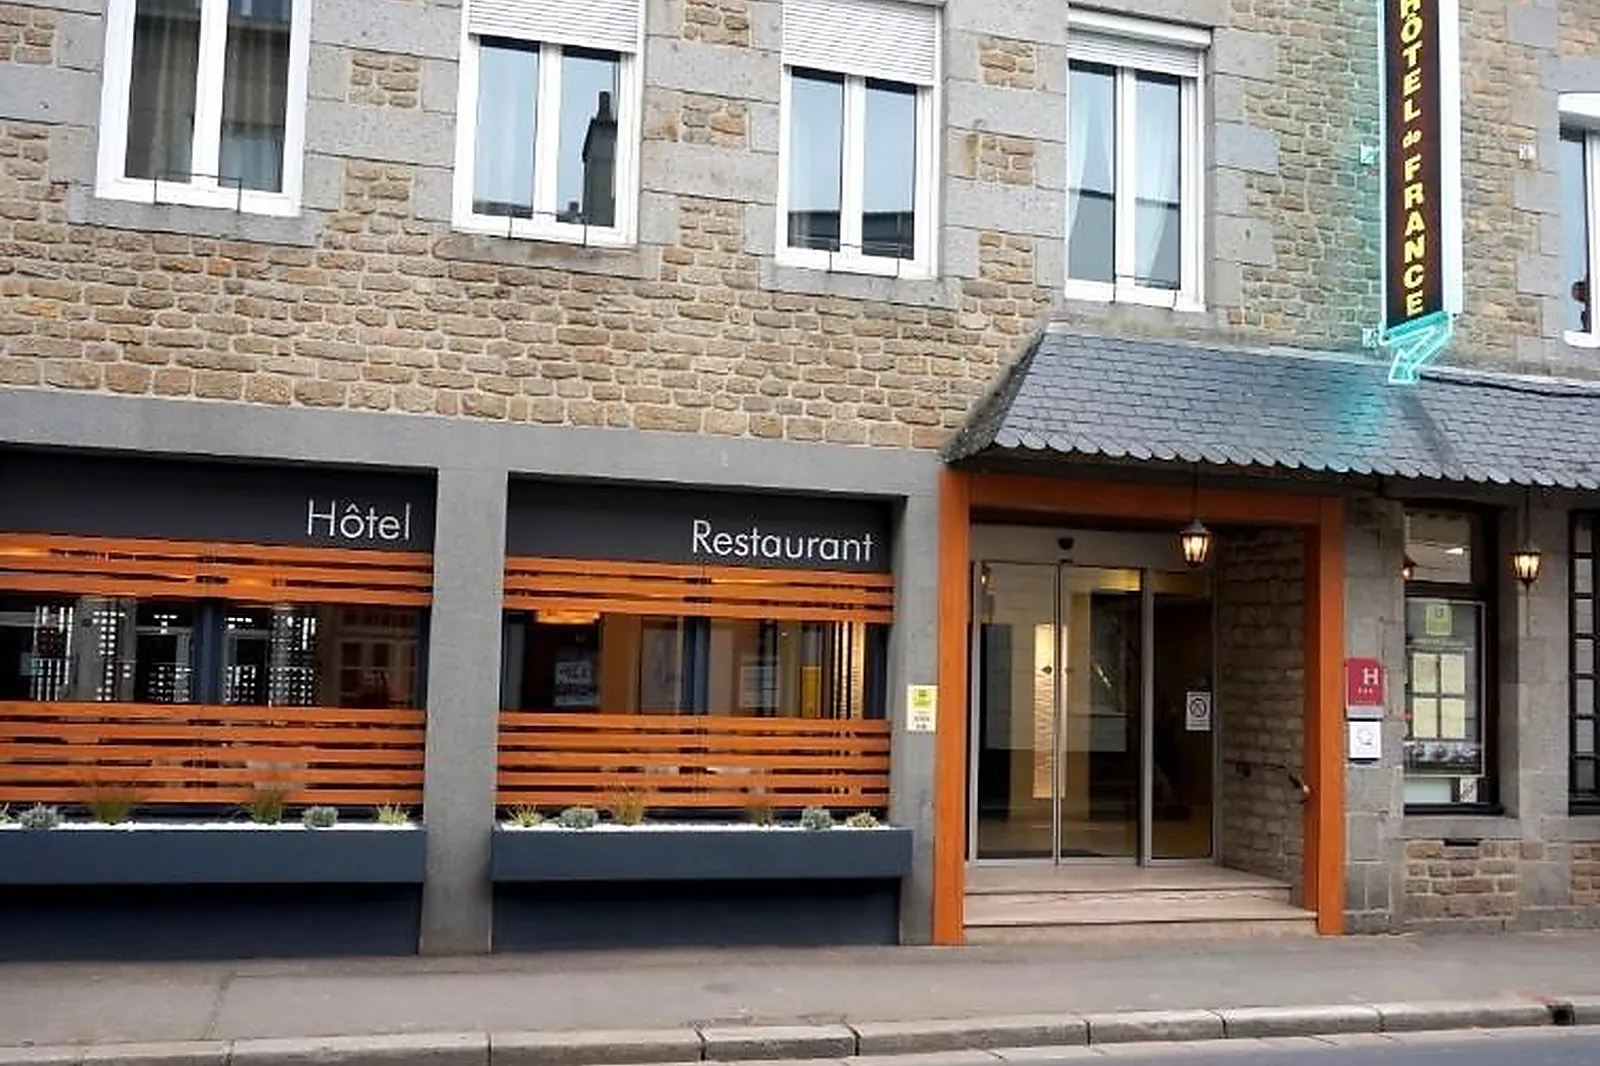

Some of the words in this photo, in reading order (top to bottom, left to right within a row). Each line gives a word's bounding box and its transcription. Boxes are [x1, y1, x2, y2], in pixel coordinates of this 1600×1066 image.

[1400, 0, 1423, 122] HÔTEL
[1403, 154, 1424, 317] FRANCE
[306, 498, 411, 541] Hôtel
[692, 519, 874, 562] Restaurant
[1363, 666, 1379, 685] H
